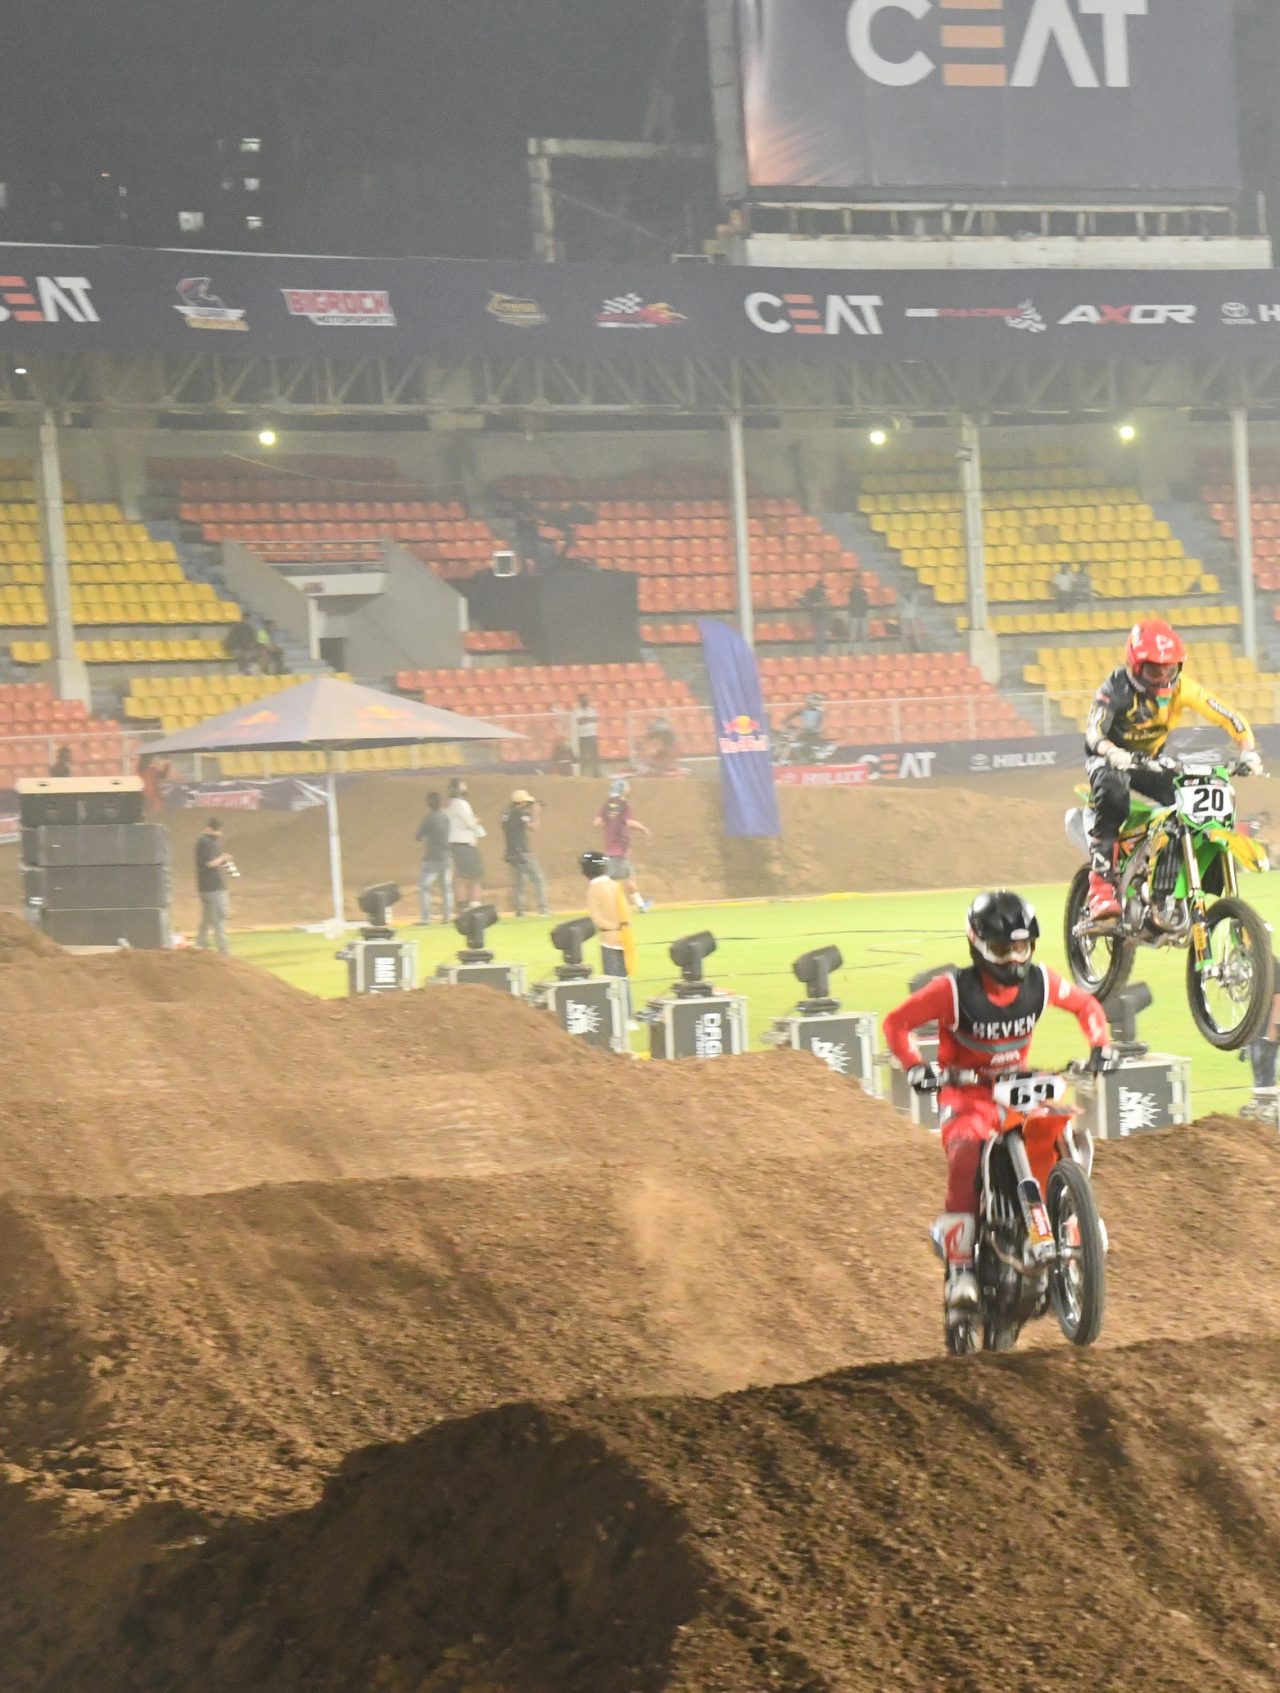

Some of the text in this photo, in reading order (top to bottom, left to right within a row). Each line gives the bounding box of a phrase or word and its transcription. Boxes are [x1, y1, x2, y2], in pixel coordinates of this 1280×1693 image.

[846, 0, 1148, 88] CEAT
[0, 275, 101, 323] EAT
[744, 292, 884, 335] CEAT
[1056, 304, 1198, 325] AXOR
[992, 750, 1058, 769] HILUX
[1192, 787, 1224, 814] 20
